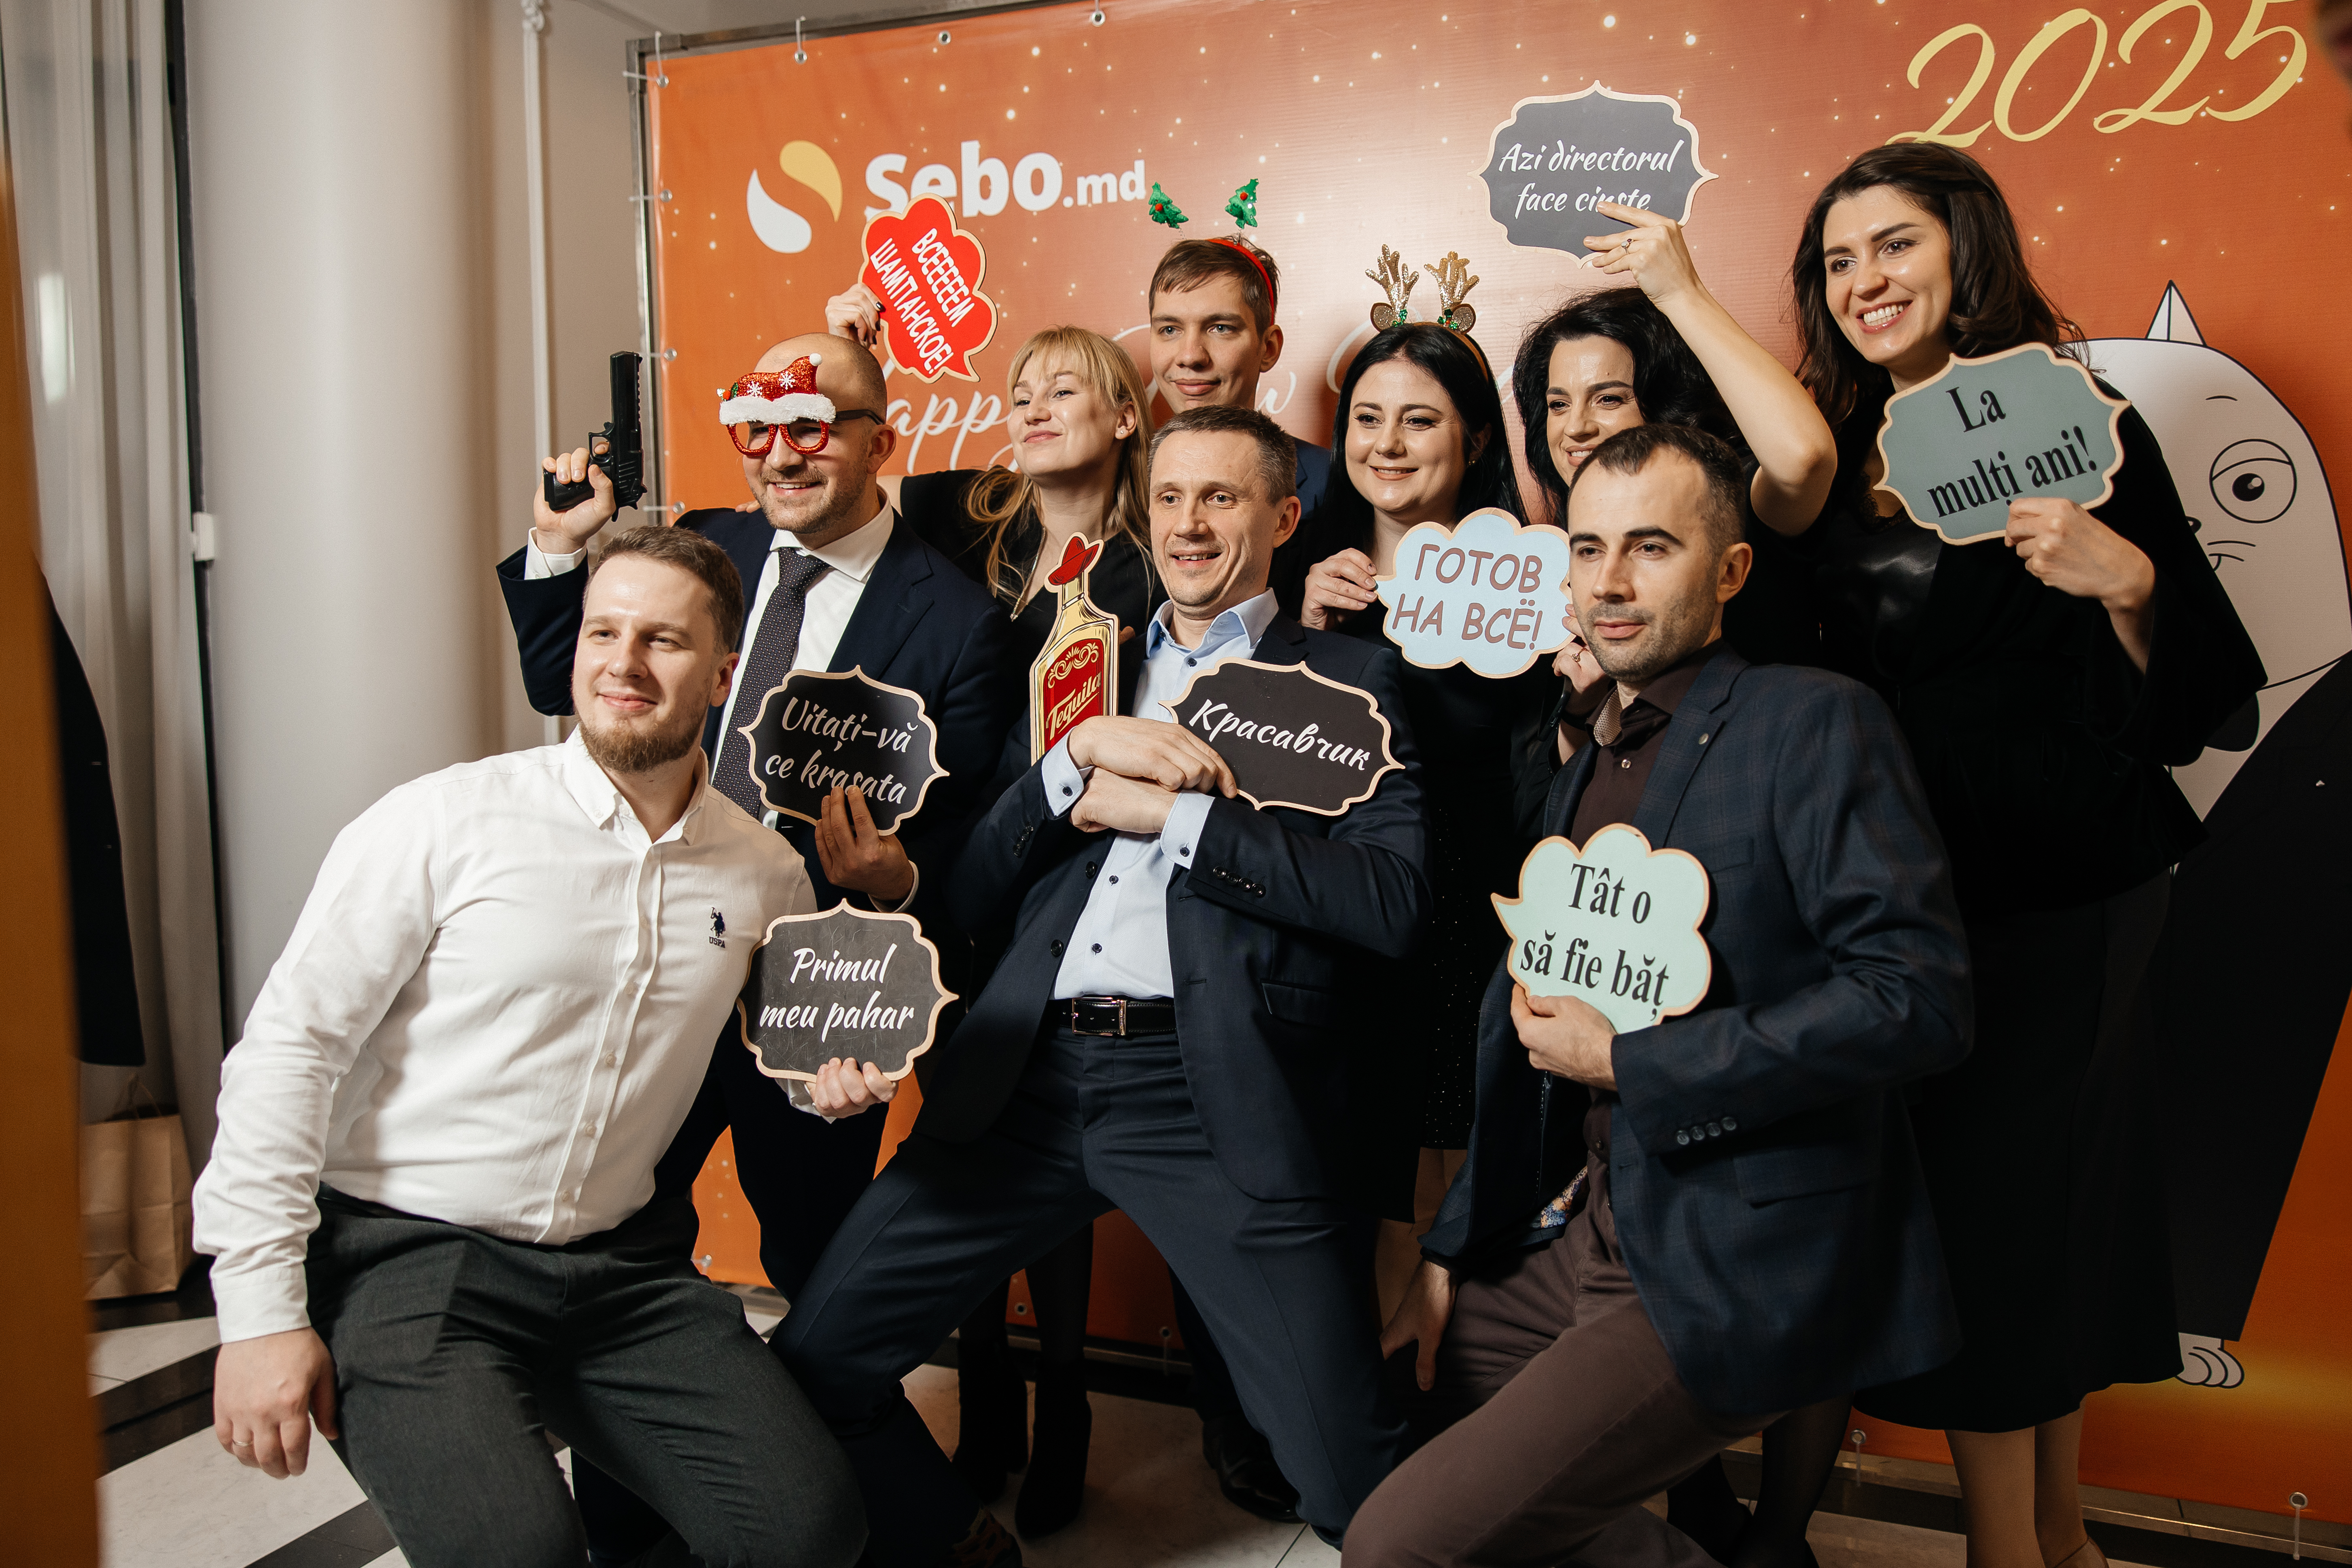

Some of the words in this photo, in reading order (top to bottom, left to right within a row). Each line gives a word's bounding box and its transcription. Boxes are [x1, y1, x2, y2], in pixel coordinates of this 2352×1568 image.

[1884, 0, 2307, 148] 2025
[1498, 143, 1547, 172] Azi
[1548, 140, 1684, 172] directorul
[1515, 182, 1568, 219] face
[870, 237, 954, 374] ШАМПАНСКОЕ!
[911, 228, 975, 327] ВСЕЕЕЕЕМ
[1946, 386, 2006, 432] La
[2025, 426, 2097, 488] ani!
[1415, 543, 1543, 593] ГОТОВ
[1392, 593, 1443, 636] НА
[1461, 598, 1543, 650] ВСЁ!
[782, 697, 918, 752] Uitați-vă
[1046, 671, 1101, 741] Tequila
[1189, 699, 1370, 770] Красавчик
[765, 754, 795, 778] ce
[1568, 863, 1625, 917] Tât
[1632, 891, 1651, 924] o
[709, 936, 725, 949] USPA
[790, 943, 897, 983] Primul
[1520, 929, 1556, 976] să
[1560, 938, 1602, 988] fie
[1610, 949, 1669, 1021] băț
[759, 1004, 819, 1028] meu
[821, 990, 914, 1043] pahar
